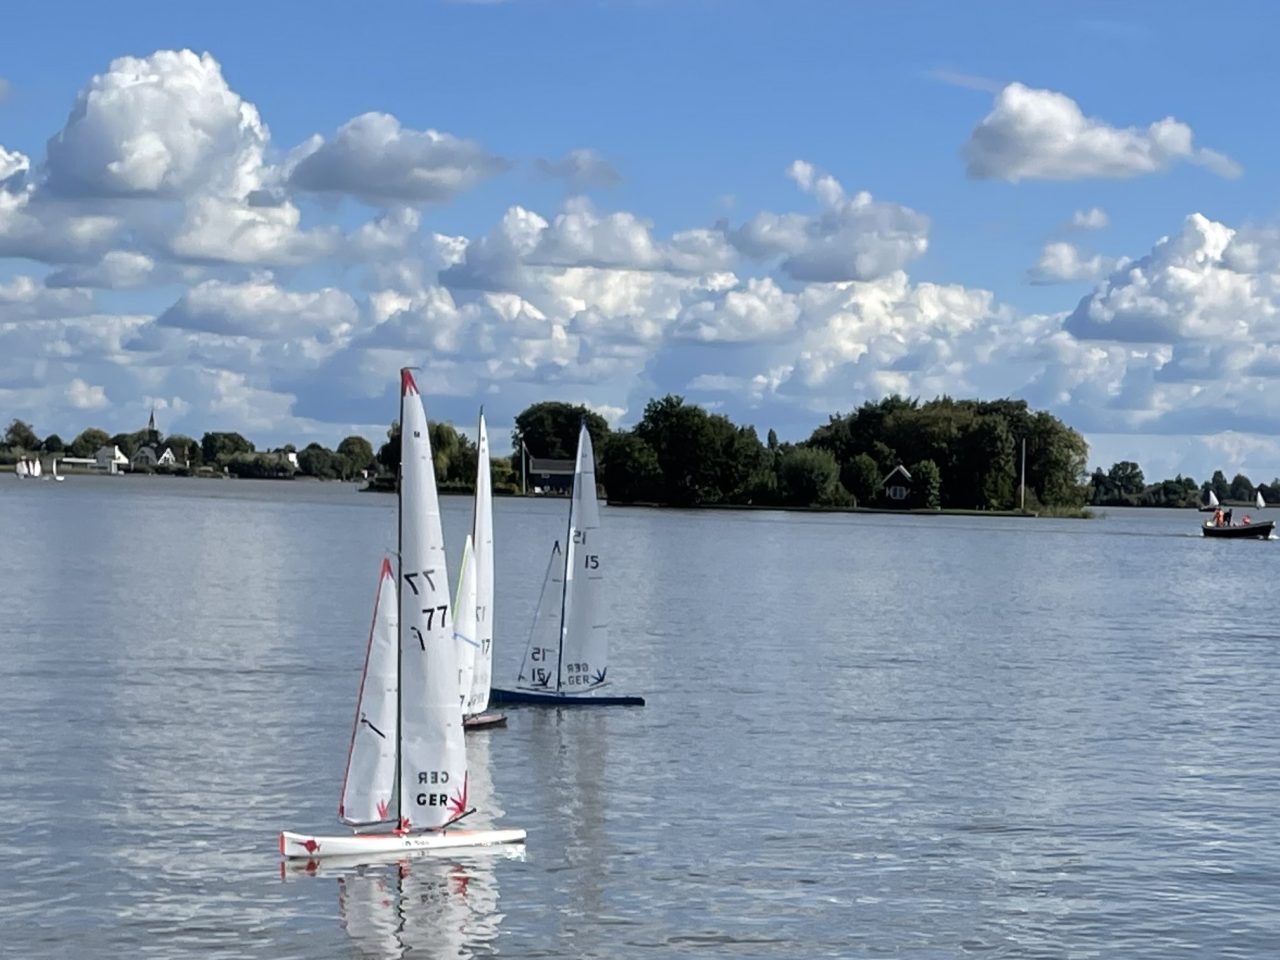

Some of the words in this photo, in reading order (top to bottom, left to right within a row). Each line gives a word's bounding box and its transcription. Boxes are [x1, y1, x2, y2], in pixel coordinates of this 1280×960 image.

[584, 554, 600, 570] 15
[421, 604, 448, 632] 77
[416, 792, 449, 807] GER
